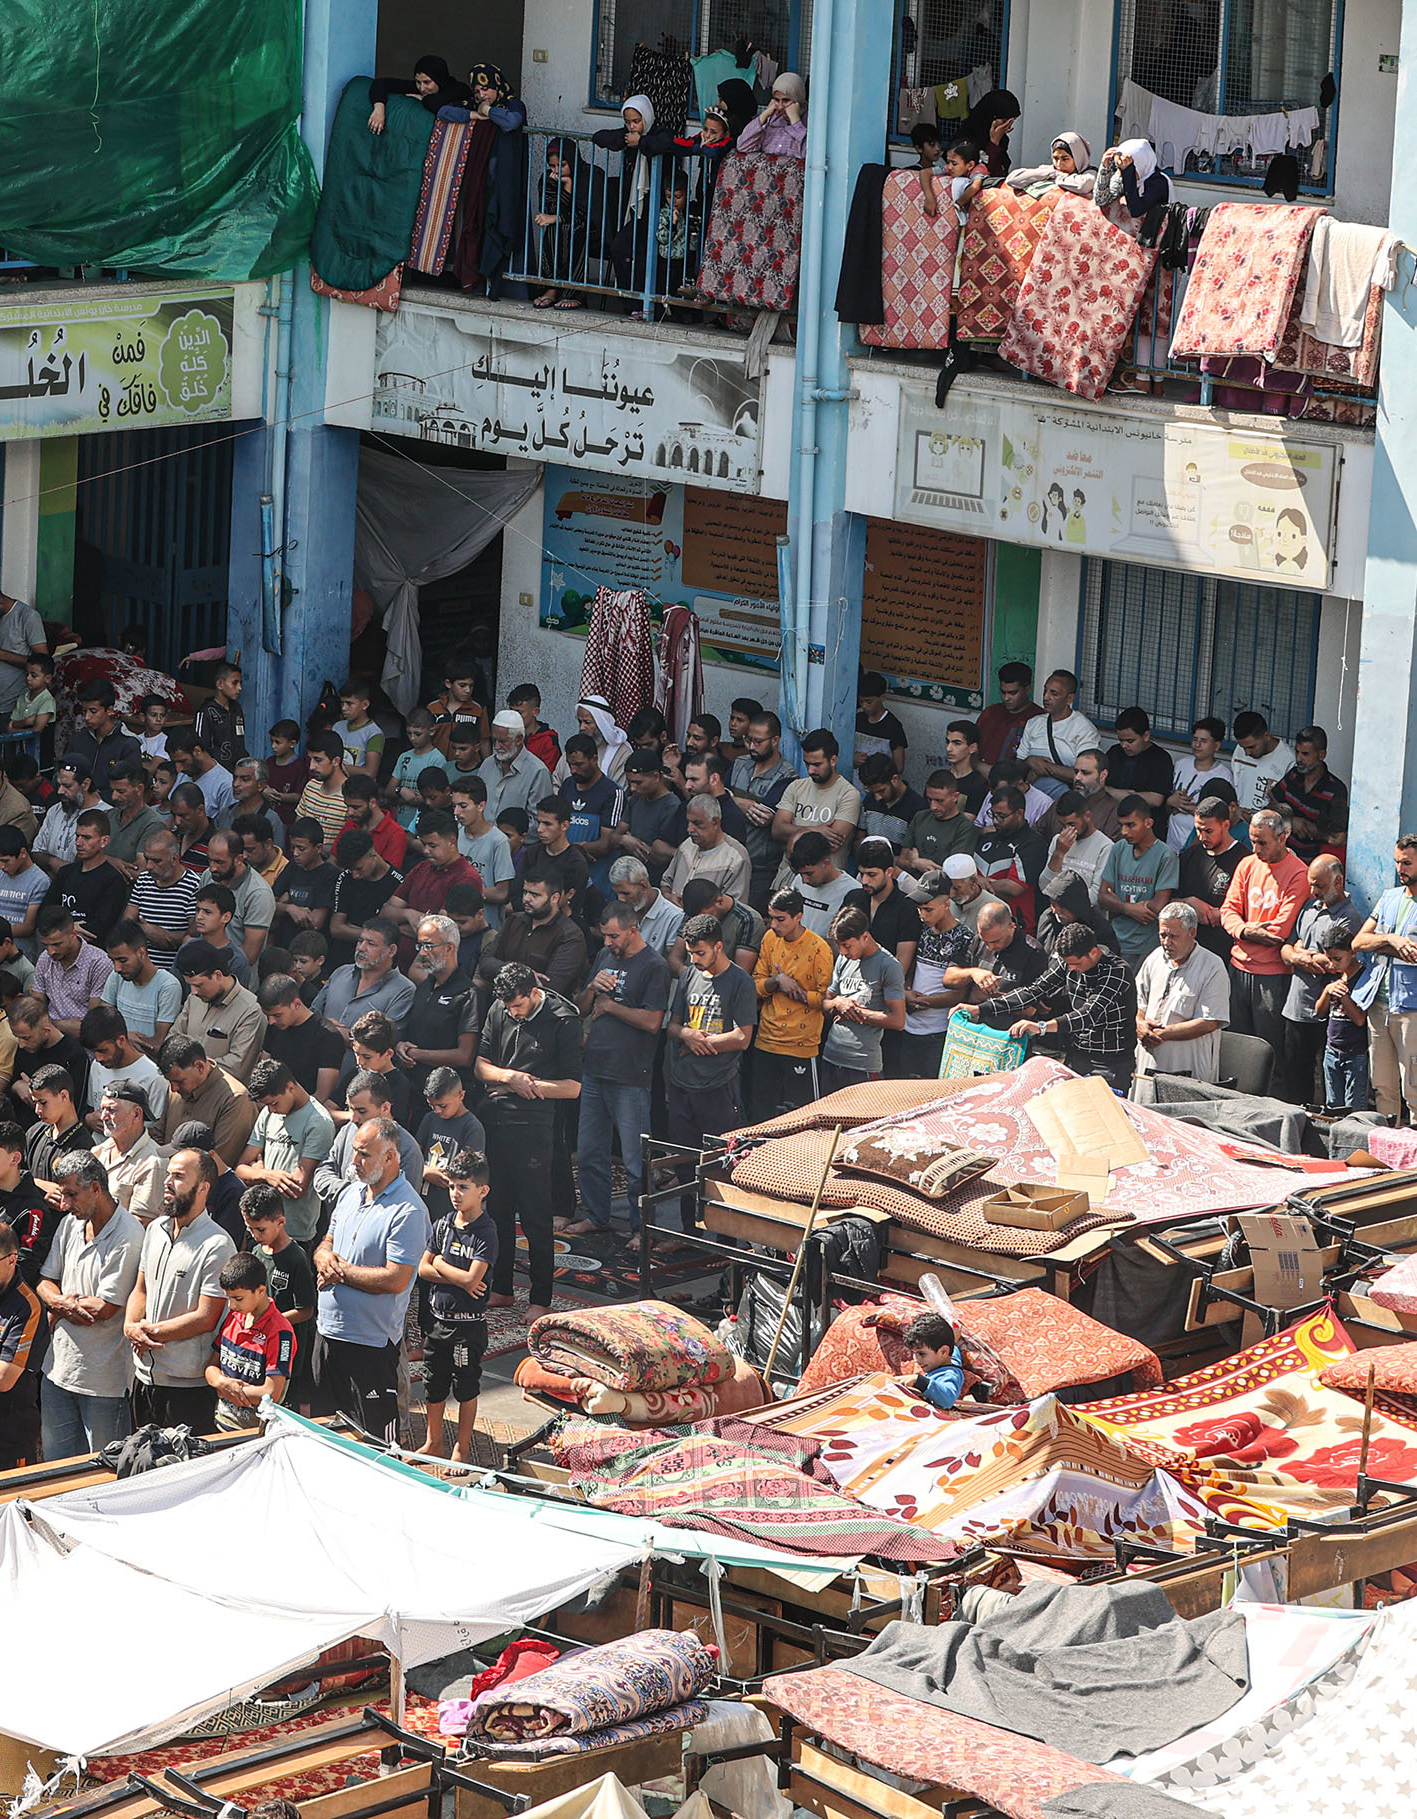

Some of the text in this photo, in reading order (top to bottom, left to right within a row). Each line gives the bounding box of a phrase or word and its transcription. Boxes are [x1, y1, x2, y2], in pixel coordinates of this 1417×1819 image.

[74, 308, 98, 317] يونس
[99, 306, 112, 314] خان
[115, 304, 143, 312] مدرسة
[98, 383, 111, 423] في
[481, 417, 528, 453] يوم
[455, 713, 476, 724] PUMA
[794, 802, 831, 822] POLO
[843, 977, 863, 989] NIKE
[689, 993, 720, 1005] OFF
[432, 1133, 451, 1143] WHITE
